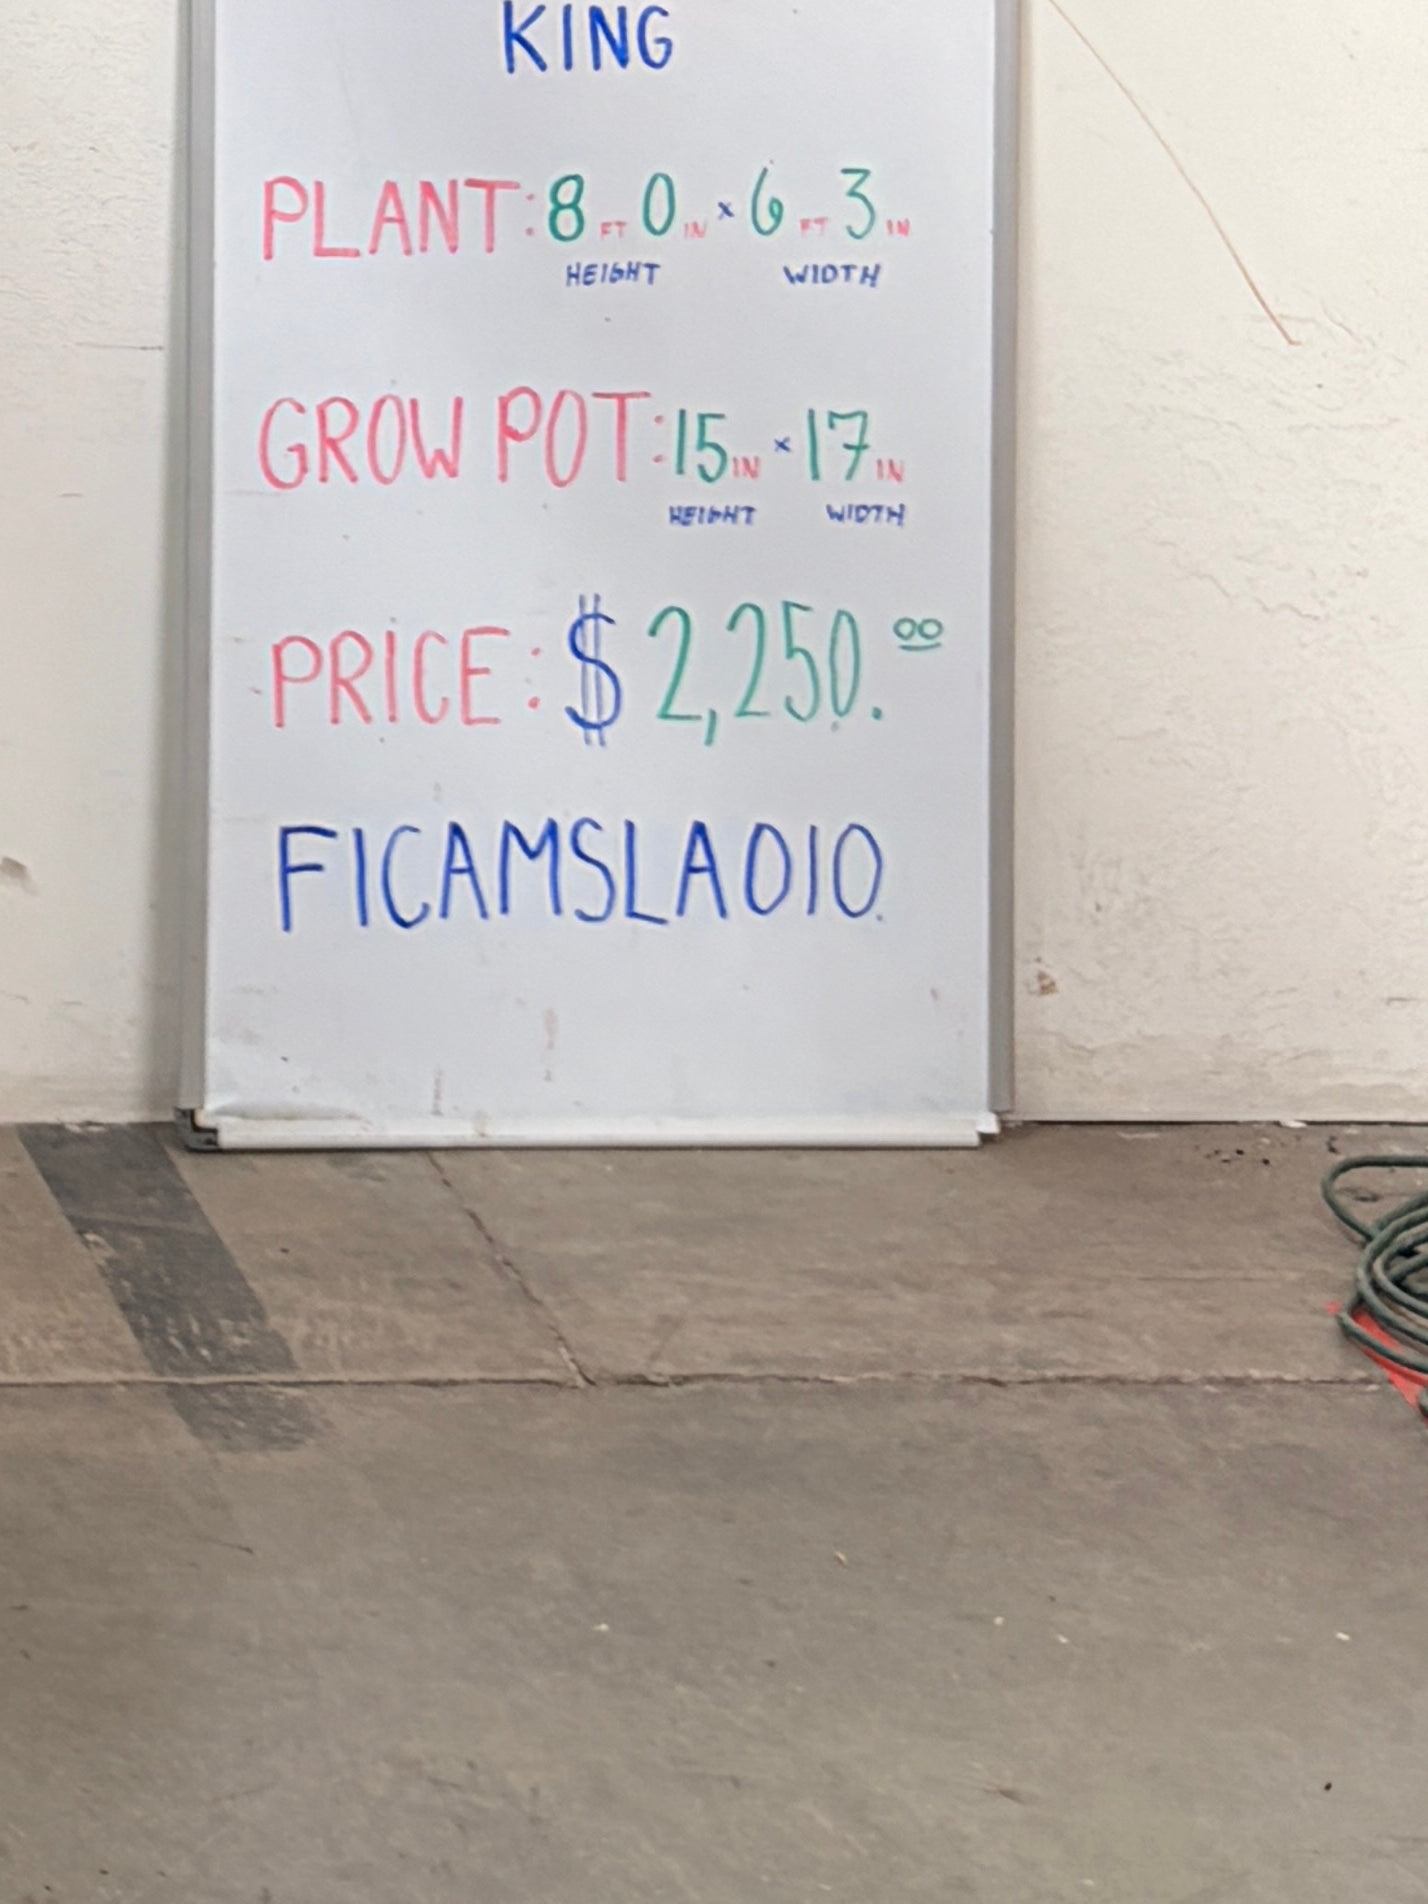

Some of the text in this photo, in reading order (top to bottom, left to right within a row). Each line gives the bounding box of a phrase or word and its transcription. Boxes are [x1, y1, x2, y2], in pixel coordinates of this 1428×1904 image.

[502, 0, 674, 75] KING
[261, 175, 536, 262] PLANT:
[564, 260, 882, 290] HEIGHT WIDTH
[257, 394, 465, 492] GROW
[496, 385, 665, 490] POT:
[668, 502, 906, 528] HEIGHT WIDTH
[269, 625, 543, 728] PRICE:
